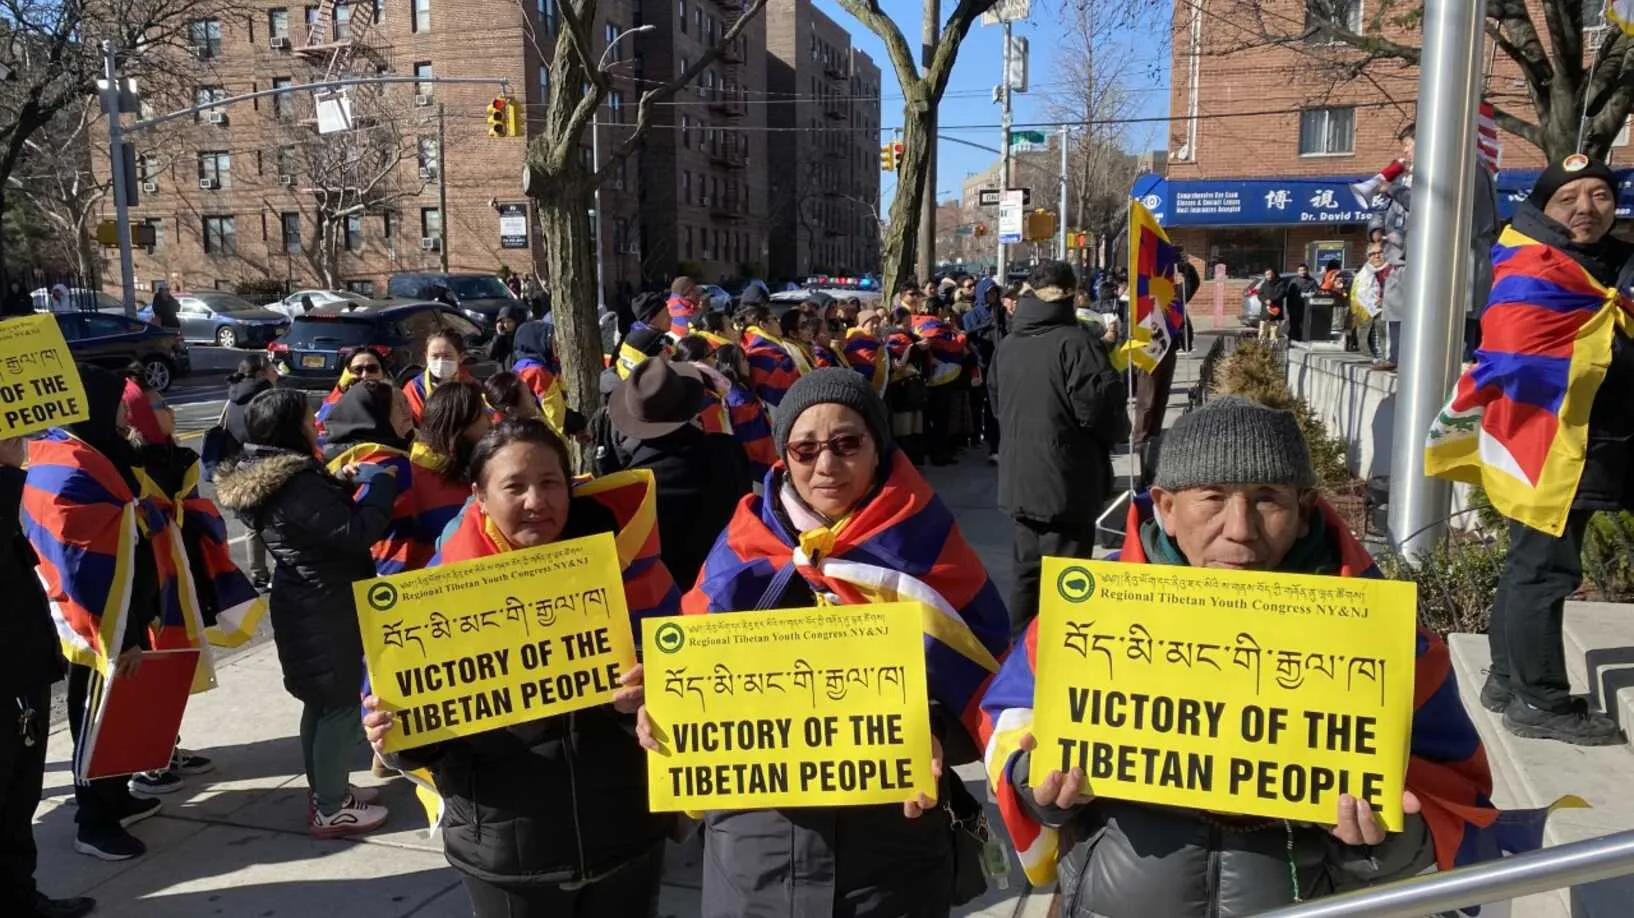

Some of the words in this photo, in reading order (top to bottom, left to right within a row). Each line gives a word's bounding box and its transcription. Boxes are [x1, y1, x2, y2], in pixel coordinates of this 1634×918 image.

[1301, 212, 1316, 221] Dr.
[1319, 211, 1352, 221] David
[0, 384, 25, 404] OF
[29, 375, 69, 397] THE
[4, 398, 80, 429] PEOPLE
[402, 586, 442, 602] Regional
[446, 579, 480, 592] Tibetan
[482, 574, 509, 586] Youth
[511, 566, 552, 580] Congress
[554, 557, 589, 571] NY&NJ
[1100, 588, 1154, 604] Regional
[1158, 592, 1206, 607] Tibetan
[1210, 597, 1247, 610] Youth
[1252, 599, 1312, 615] Congress
[1316, 603, 1368, 619] NY&NJ
[688, 636, 730, 649] Regional
[734, 634, 770, 644] Tibetan
[773, 632, 801, 642] Youth
[803, 629, 847, 642] Congress
[850, 626, 889, 637] NY&NJ
[395, 648, 509, 697] VICTORY
[520, 640, 552, 670] OF
[560, 627, 611, 661] THE
[395, 687, 513, 737] TIBETAN
[520, 662, 624, 709] PEOPLE
[672, 718, 791, 753] VICTORY
[804, 717, 838, 747] OF
[849, 714, 904, 746] THE
[1068, 687, 1226, 738] VICTORY
[1241, 705, 1288, 744] OF
[1303, 711, 1377, 755] THE
[668, 762, 788, 797] TIBETAN
[800, 759, 914, 792] PEOPLE
[1058, 737, 1214, 792] TIBETAN
